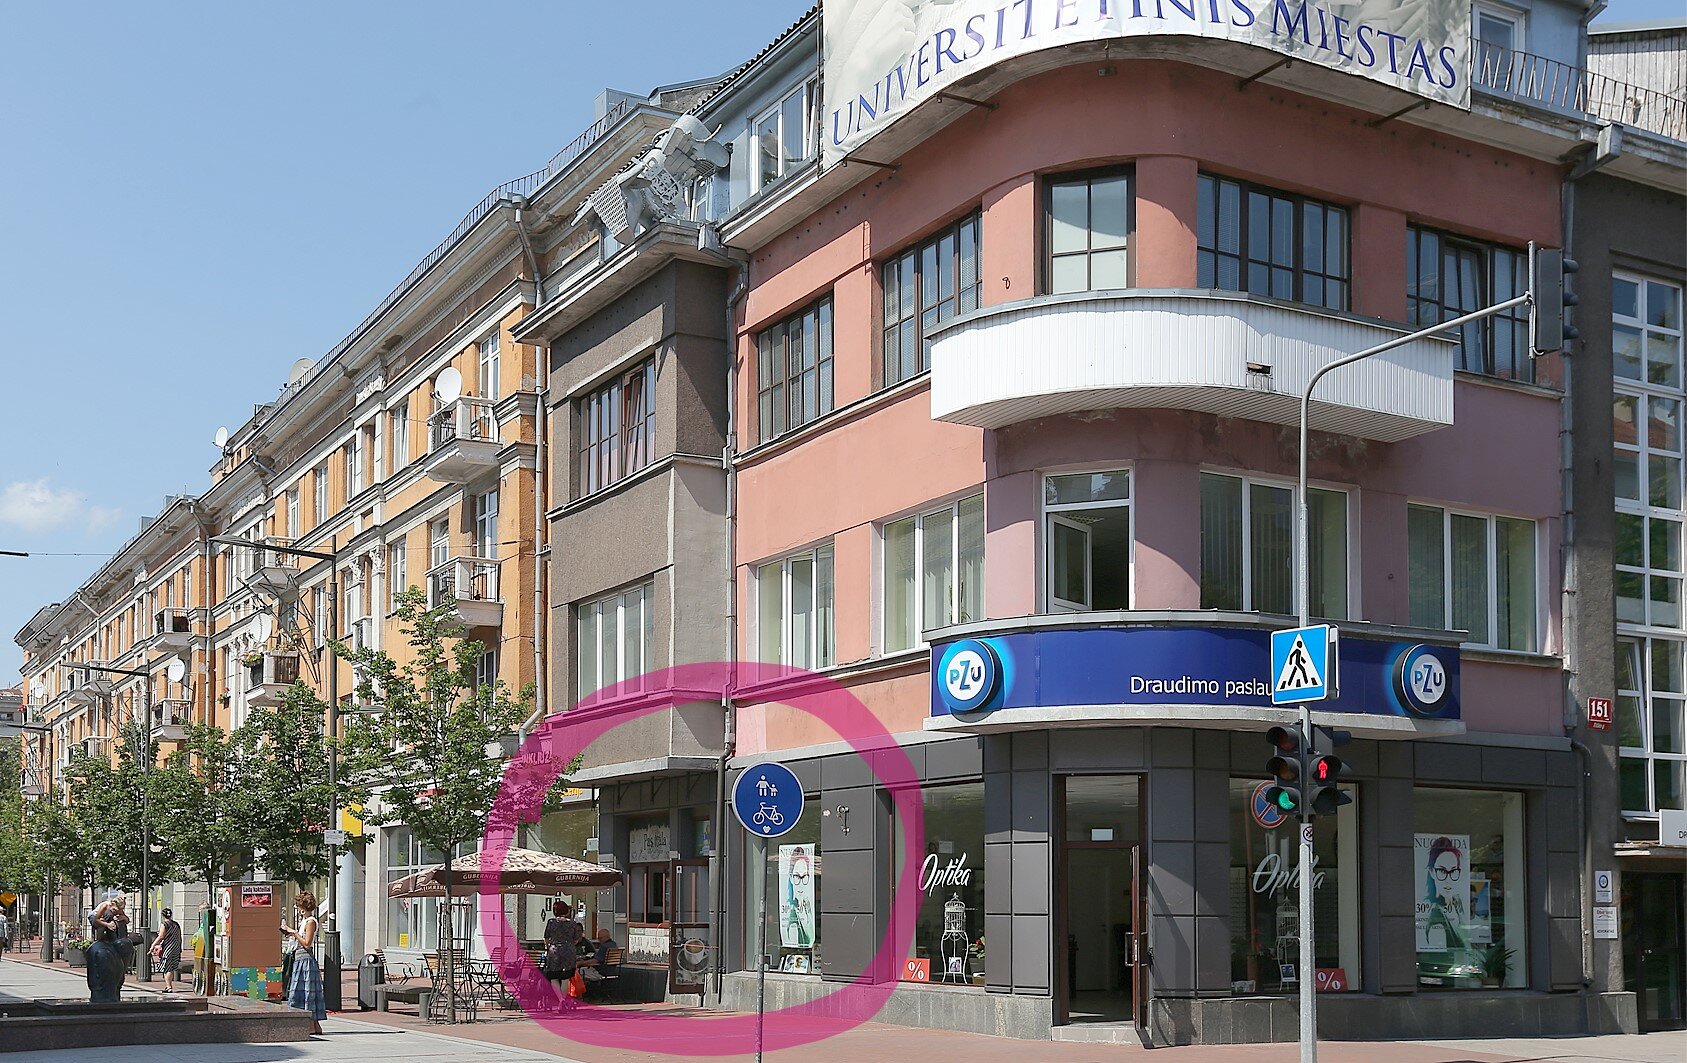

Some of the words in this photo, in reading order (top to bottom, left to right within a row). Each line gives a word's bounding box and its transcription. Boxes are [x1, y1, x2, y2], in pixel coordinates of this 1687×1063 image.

[1270, 0, 1457, 89] MIESTAS
[949, 659, 982, 691] PZU
[1130, 675, 1220, 694] Draudimo
[1414, 664, 1443, 693] PZU
[1590, 700, 1609, 718] 151
[462, 872, 499, 881] GUBERNIJA
[555, 873, 591, 882] GUBERNIJA
[918, 851, 972, 897] Optika
[1252, 853, 1326, 899] Optia
